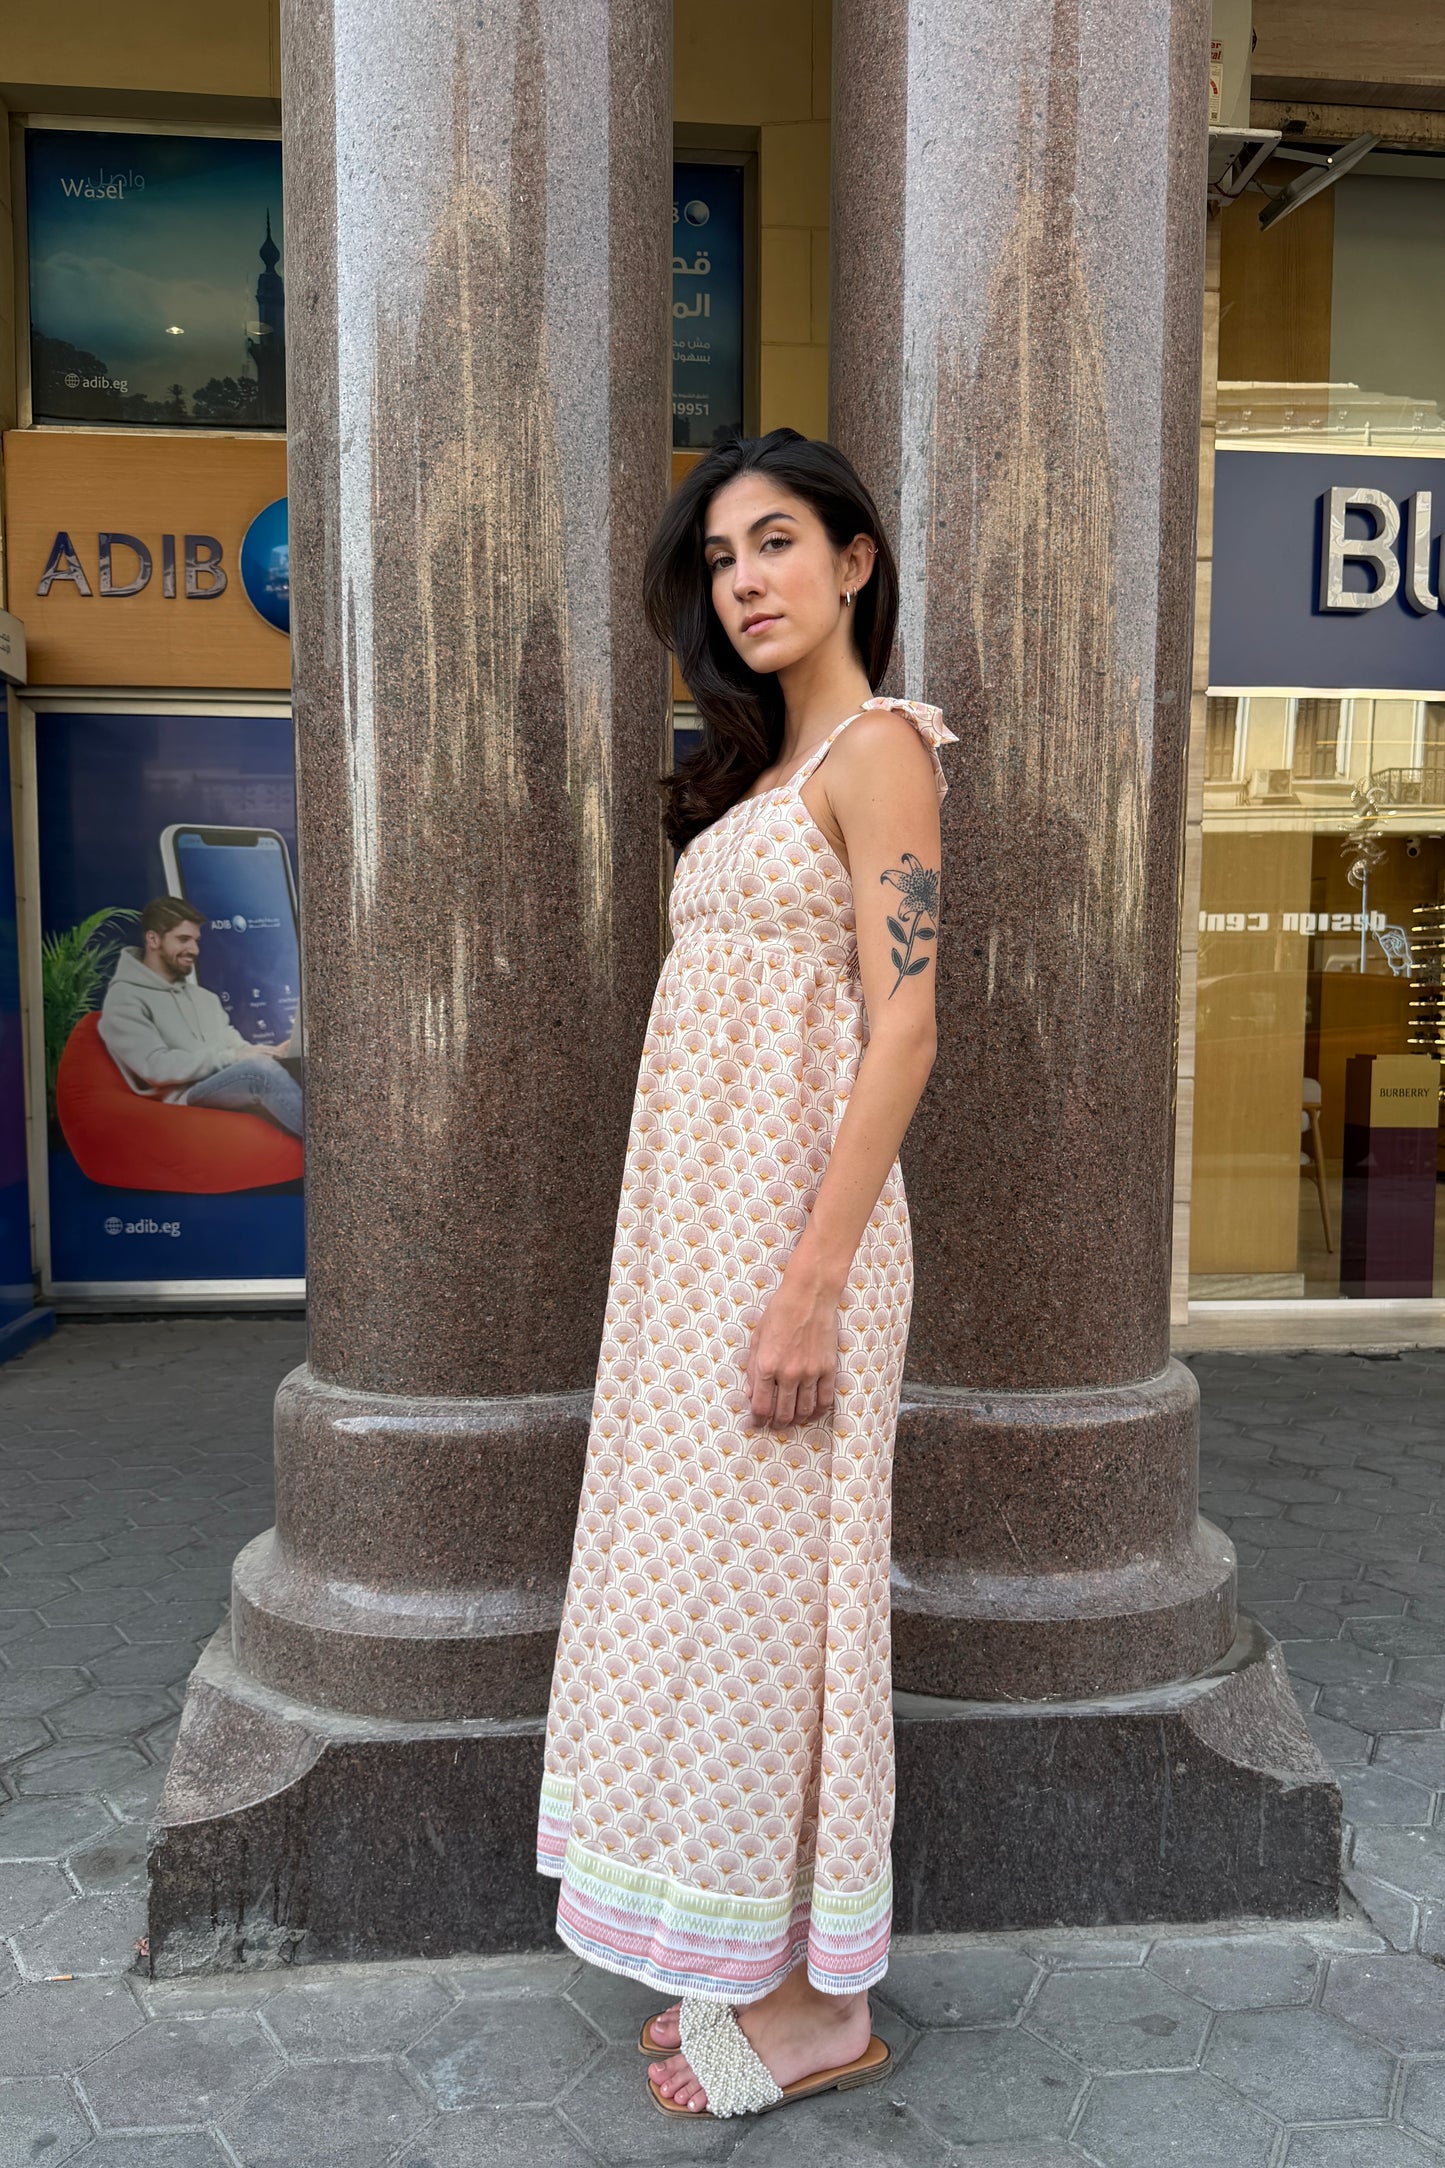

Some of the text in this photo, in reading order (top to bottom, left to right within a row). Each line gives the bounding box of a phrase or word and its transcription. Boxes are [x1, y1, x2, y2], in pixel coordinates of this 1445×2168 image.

[60, 177, 125, 200] Wasel
[82, 375, 129, 393] adib.eg
[1318, 486, 1445, 615] Bl
[36, 531, 228, 600] ADIB
[1379, 1087, 1430, 1098] BURBERRY
[125, 1218, 182, 1238] adib.eg
